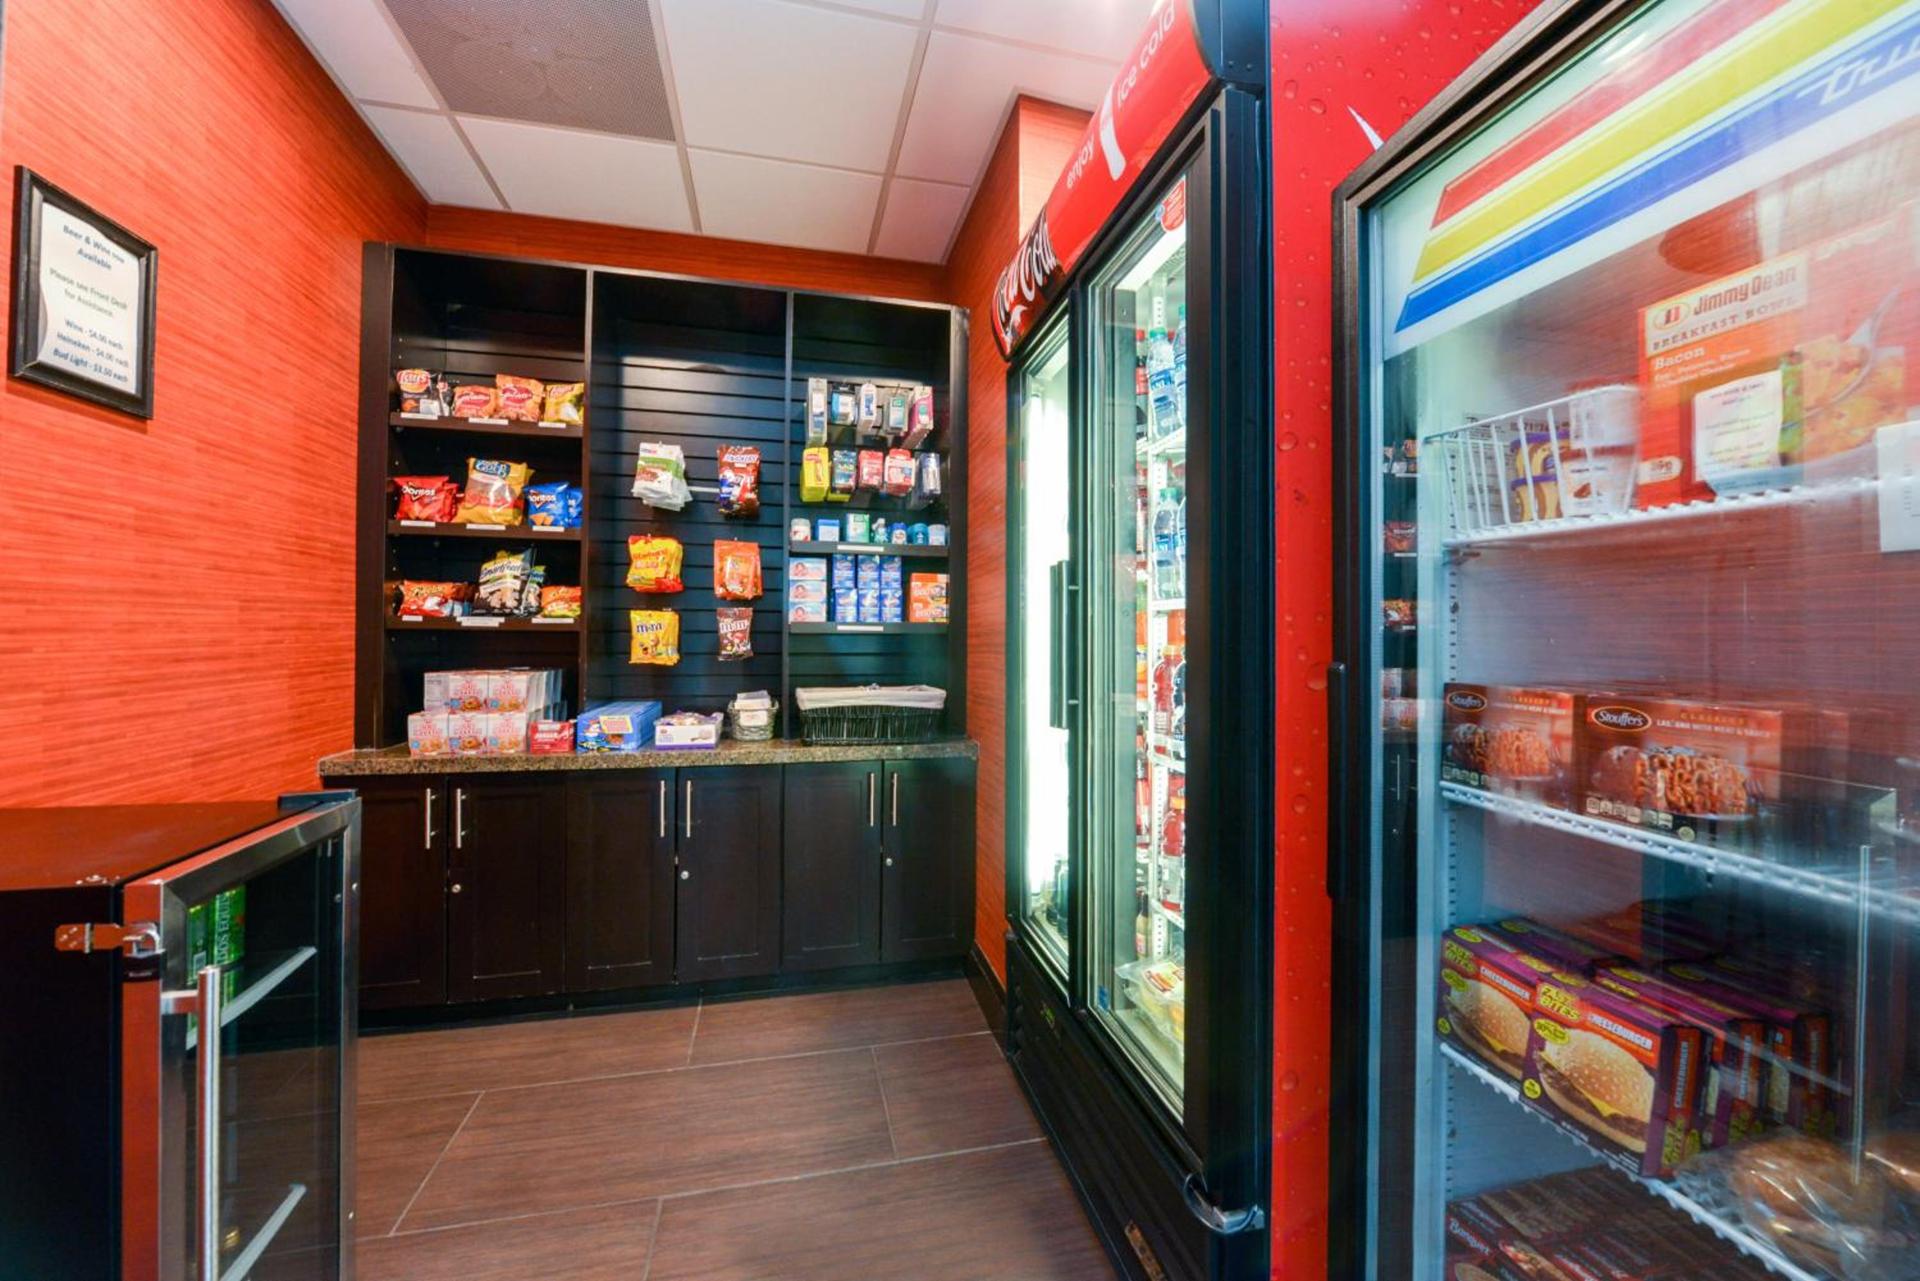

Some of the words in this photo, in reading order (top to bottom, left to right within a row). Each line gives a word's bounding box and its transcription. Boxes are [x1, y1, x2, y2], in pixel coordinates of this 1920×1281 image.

[1117, 66, 1137, 108] ice
[1140, 1, 1176, 70] cold
[1066, 133, 1095, 189] enjoy
[63, 224, 83, 240] Beer
[92, 239, 111, 255] Wine
[77, 247, 112, 271] Available
[1693, 282, 1749, 316] Jimmy
[1751, 266, 1797, 296] Dean
[1652, 313, 1740, 352] BREAKFAST
[53, 346, 70, 361] Bud
[69, 353, 89, 369] Light
[1655, 347, 1705, 370] Bacon
[1599, 710, 1645, 728] Stouffer's
